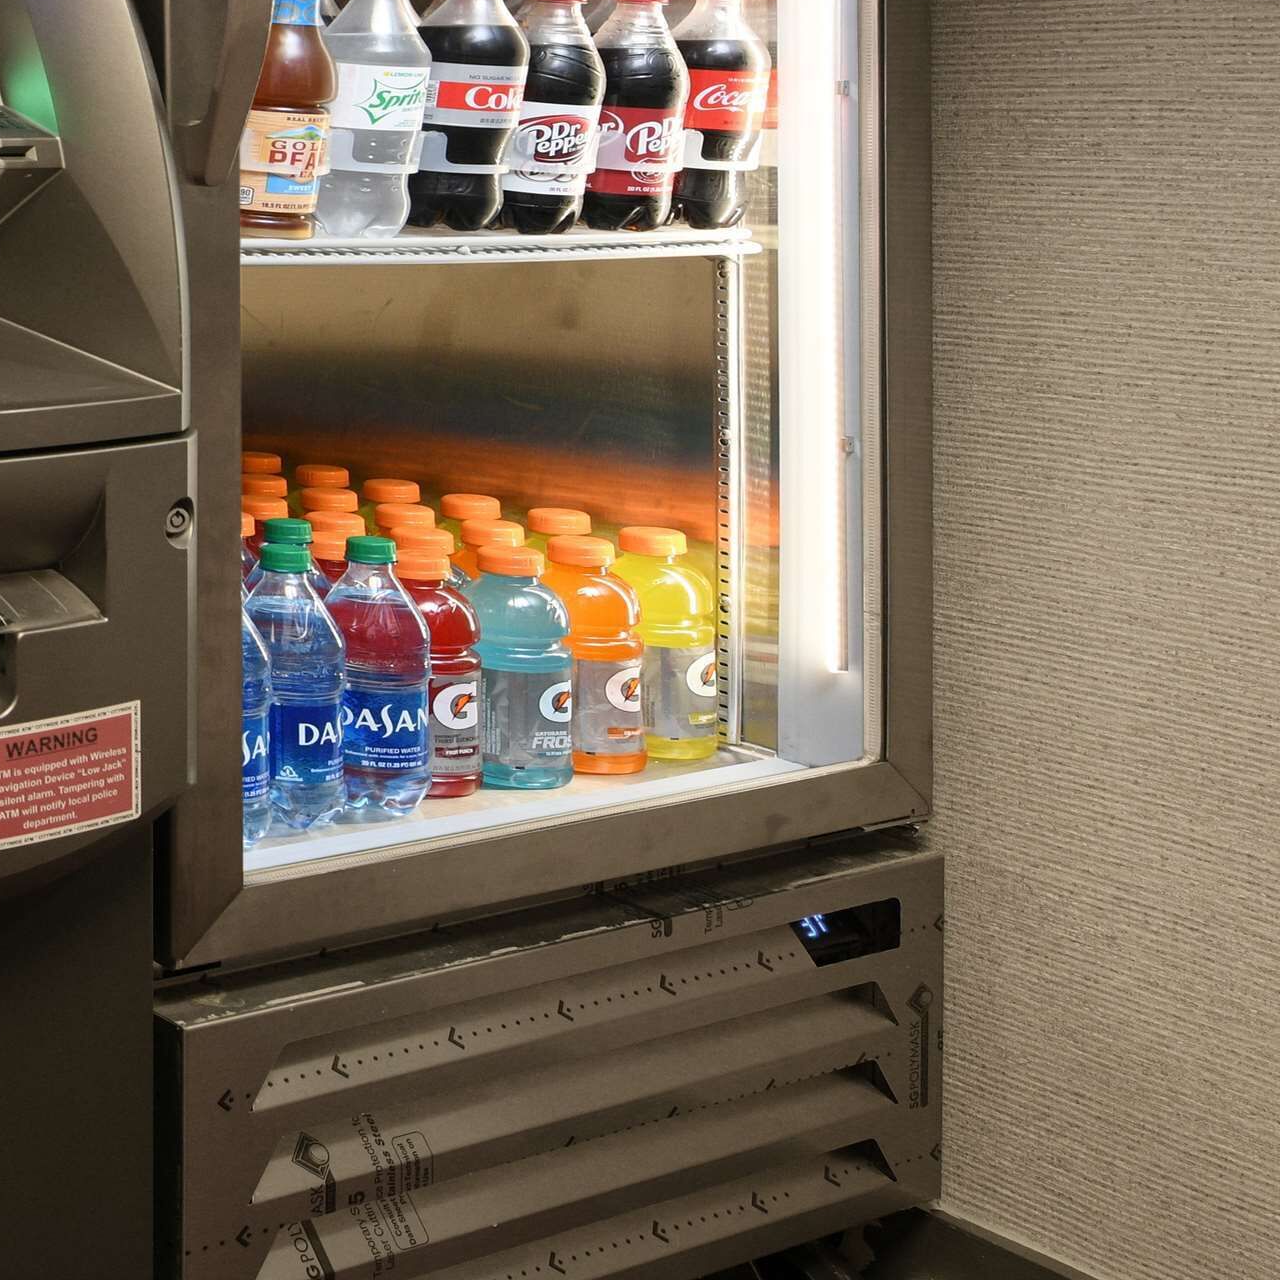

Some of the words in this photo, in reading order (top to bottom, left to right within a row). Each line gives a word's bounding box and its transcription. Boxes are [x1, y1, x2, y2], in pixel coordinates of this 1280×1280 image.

[553, 123, 581, 141] Dr
[433, 682, 479, 730] G
[6, 726, 99, 759] WARNING
[365, 746, 400, 754] PURIFIED
[401, 746, 422, 754] WATER
[13, 767, 22, 777] is
[24, 760, 68, 776] equipped
[70, 754, 88, 766] with
[89, 747, 127, 762] Wireless
[0, 793, 26, 806] silent
[27, 789, 56, 801] alarm.
[58, 778, 105, 795] Tampering
[106, 773, 126, 784] with
[45, 772, 76, 784] Device
[22, 804, 39, 816] will
[41, 799, 67, 813] notify
[68, 793, 91, 805] local
[92, 788, 119, 804] police
[23, 811, 79, 831] department.
